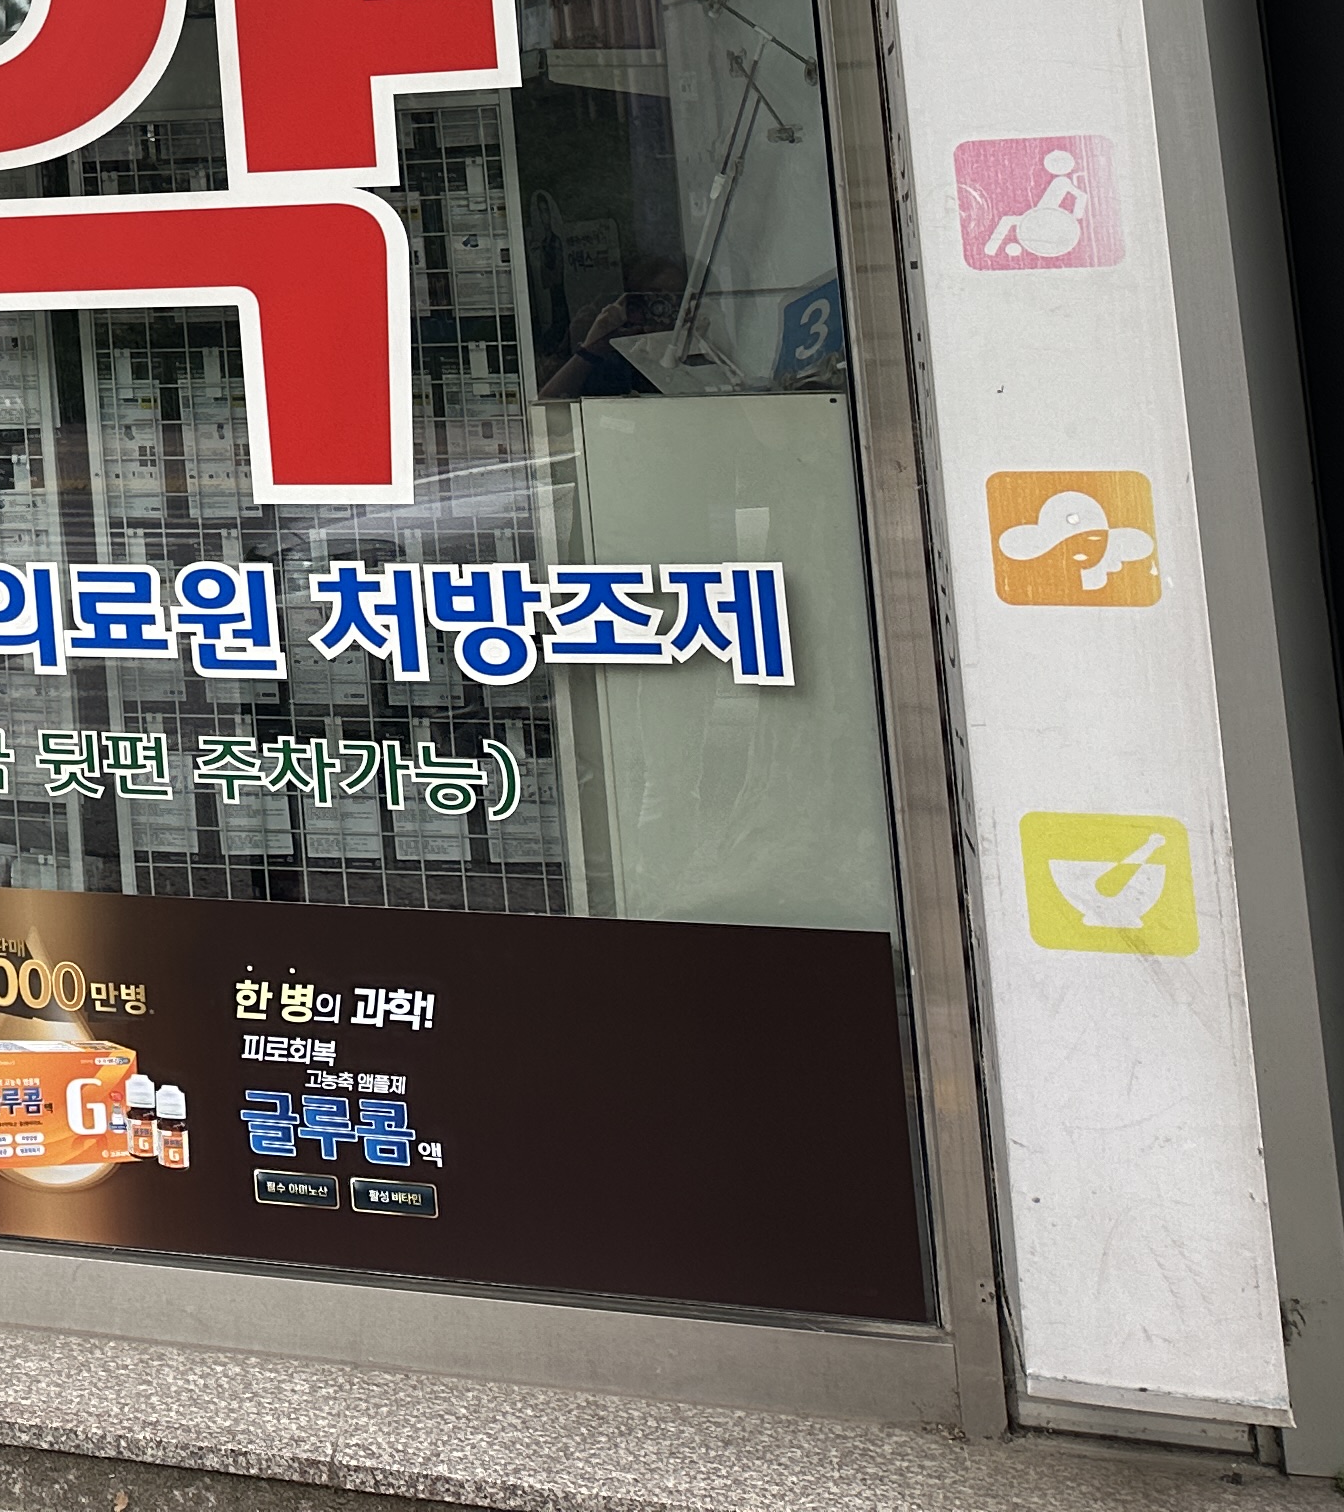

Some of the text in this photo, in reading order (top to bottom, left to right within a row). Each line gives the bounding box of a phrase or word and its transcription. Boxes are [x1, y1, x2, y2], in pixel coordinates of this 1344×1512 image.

[311, 561, 798, 687] 처방조제
[36, 726, 174, 803] 뒷편
[195, 732, 522, 820] 주차가능)
[349, 986, 435, 1031] 과학!
[241, 1034, 337, 1066] 피로회복
[304, 1069, 407, 1095] 고농축 앰플제
[240, 1089, 444, 1168] 글루콤 액
